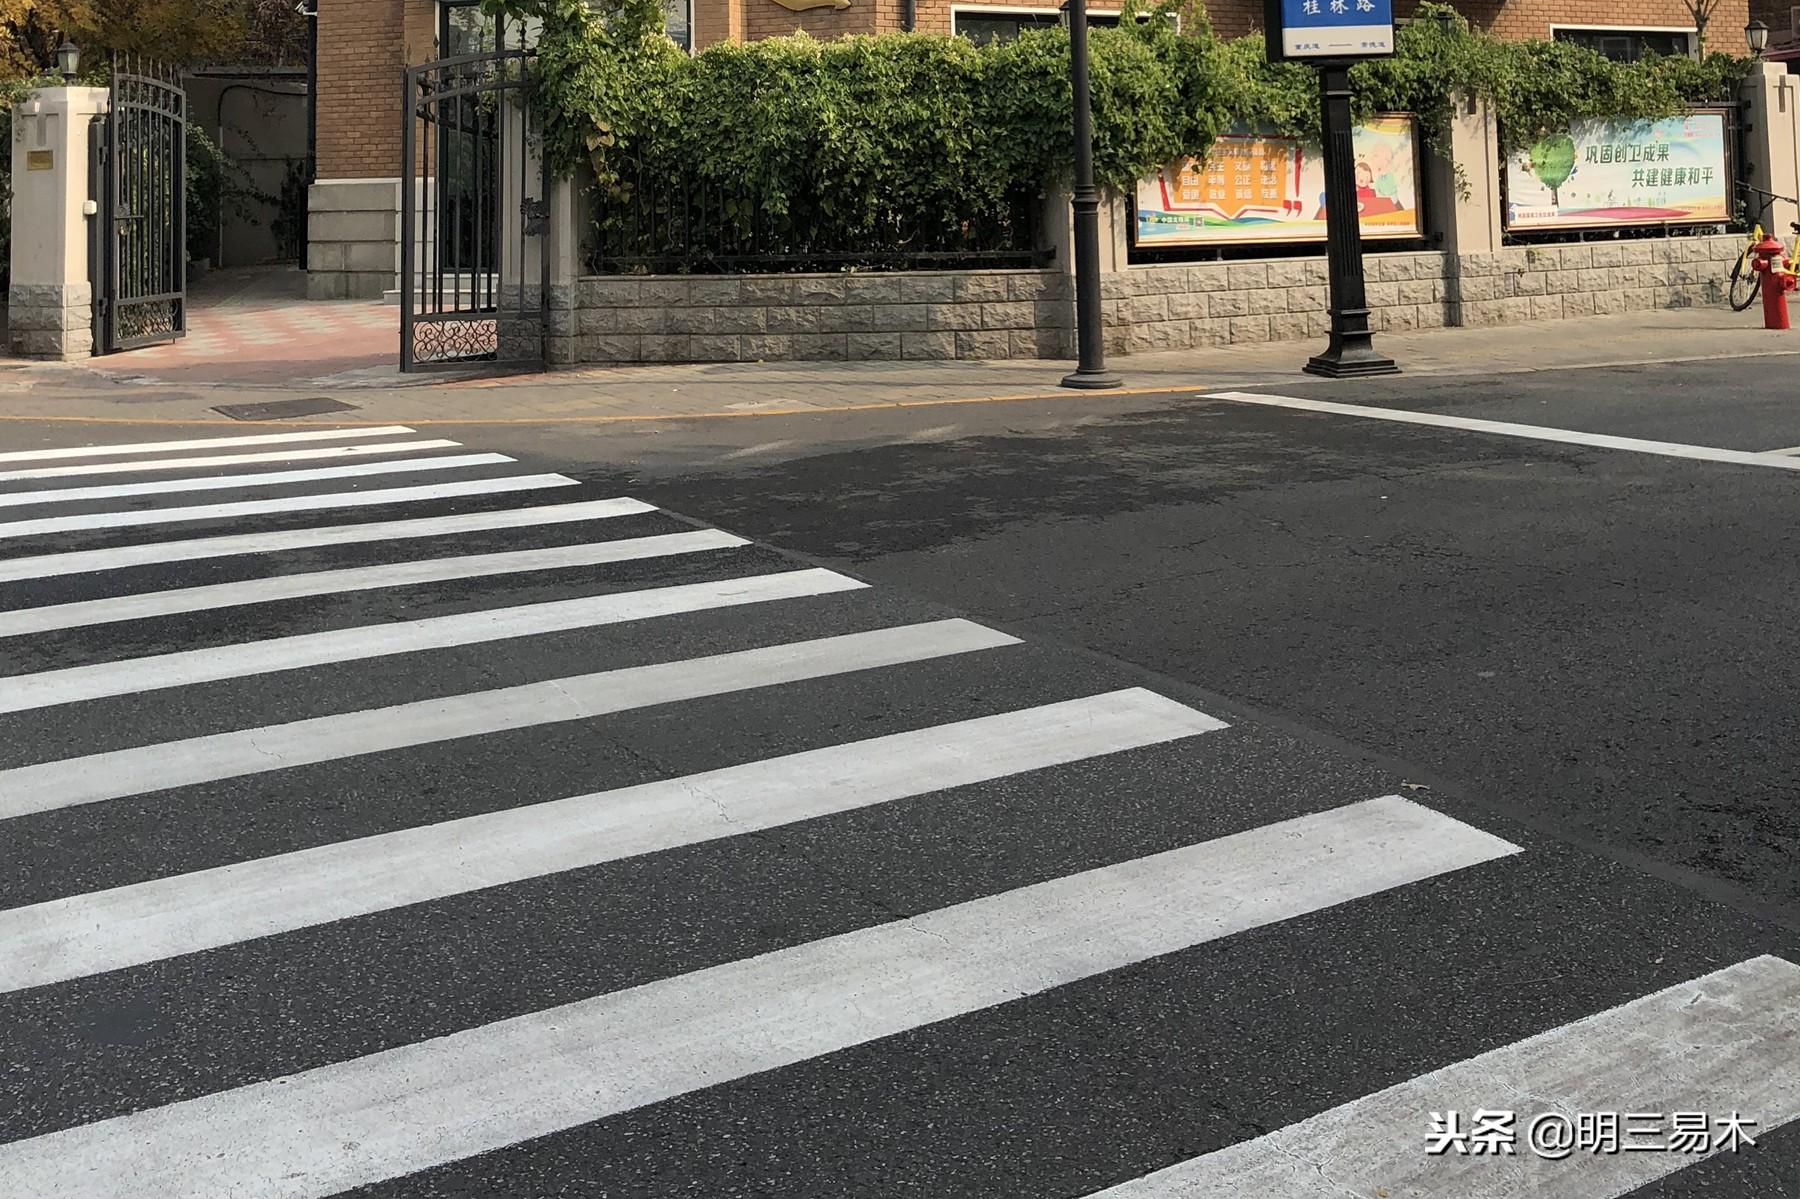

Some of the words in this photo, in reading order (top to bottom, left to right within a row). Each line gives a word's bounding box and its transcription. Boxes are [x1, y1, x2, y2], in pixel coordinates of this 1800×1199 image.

[1585, 144, 1670, 164] 巩固创卫成果
[1632, 166, 1714, 188] 共建健康和平
